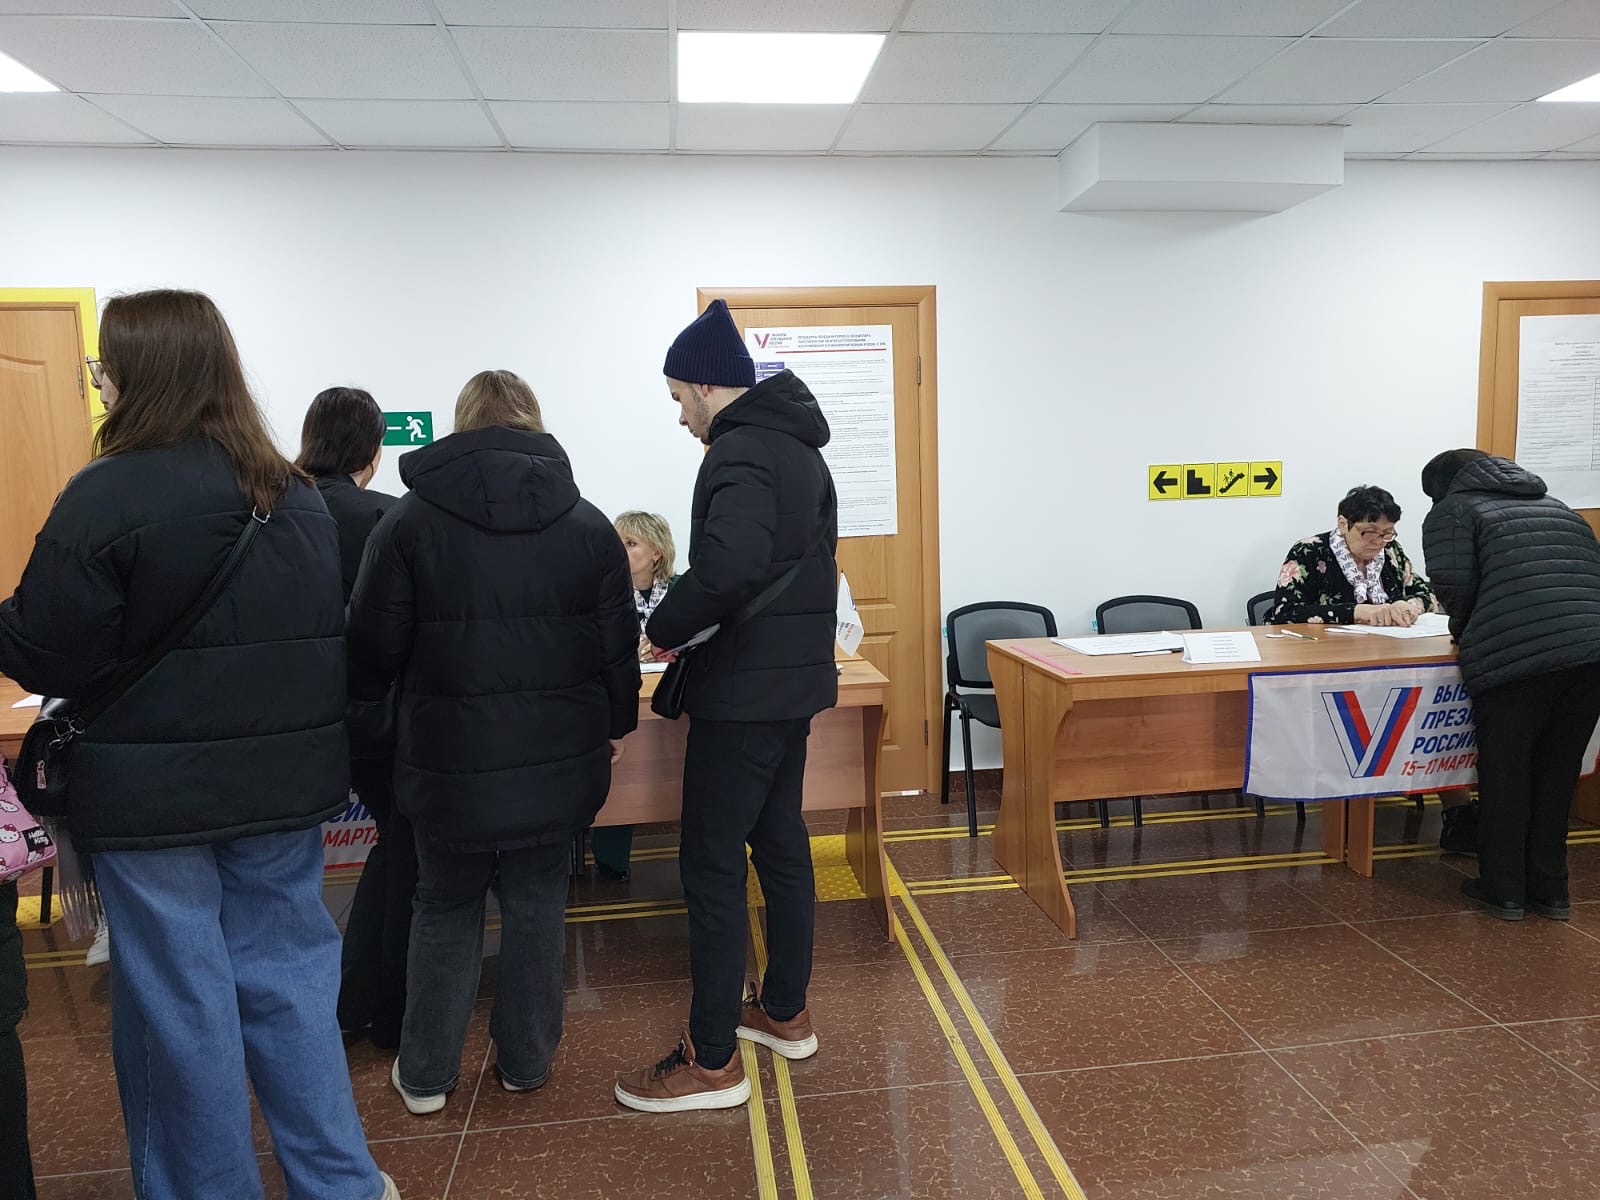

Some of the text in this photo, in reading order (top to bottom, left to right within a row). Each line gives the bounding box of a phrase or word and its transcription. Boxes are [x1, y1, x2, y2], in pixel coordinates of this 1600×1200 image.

[1432, 683, 1471, 705] ВЫБ
[1410, 730, 1478, 755] РОССИИ
[1437, 751, 1480, 773] МАРТА
